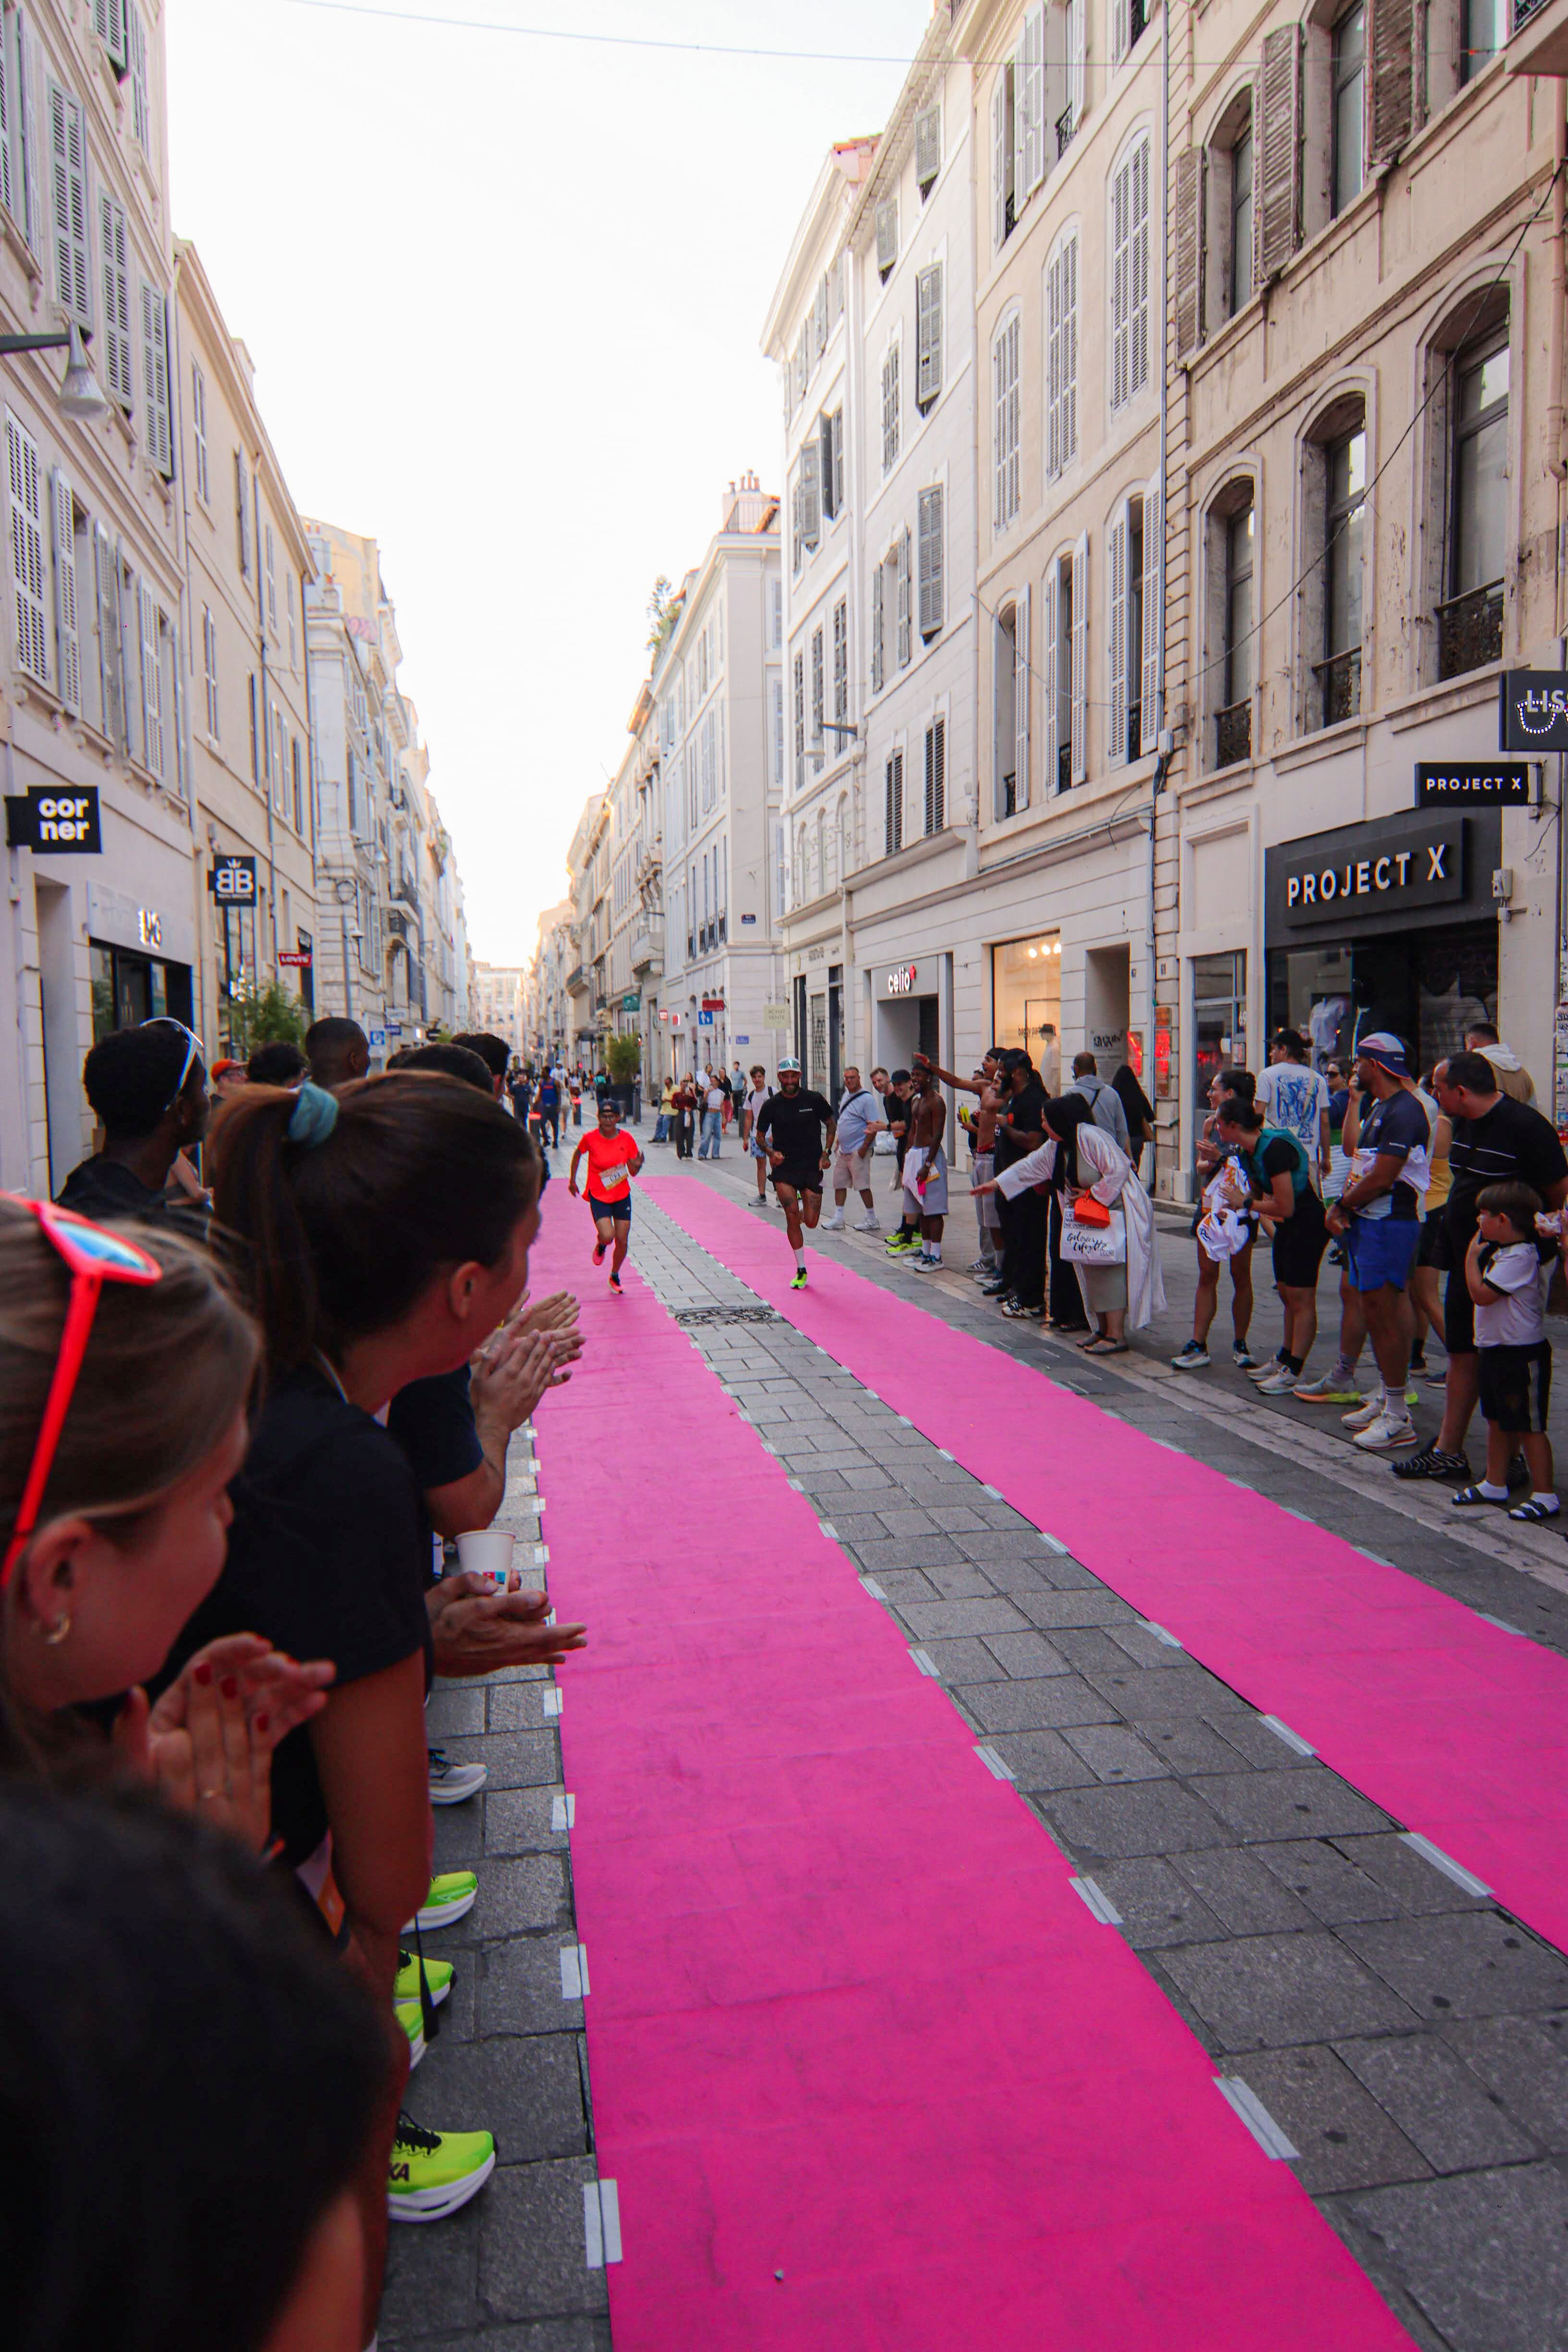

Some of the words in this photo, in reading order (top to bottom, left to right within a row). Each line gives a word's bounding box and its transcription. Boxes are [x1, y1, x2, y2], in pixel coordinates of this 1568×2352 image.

[1527, 690, 1568, 713] LIS
[1426, 777, 1503, 790] PROJECT
[1511, 777, 1522, 790] X
[38, 797, 89, 819] cor
[39, 820, 90, 841] ner
[1288, 851, 1410, 908] PROJECT
[1427, 843, 1445, 881] X
[888, 966, 911, 994] celio
[391, 2162, 409, 2181] KA
